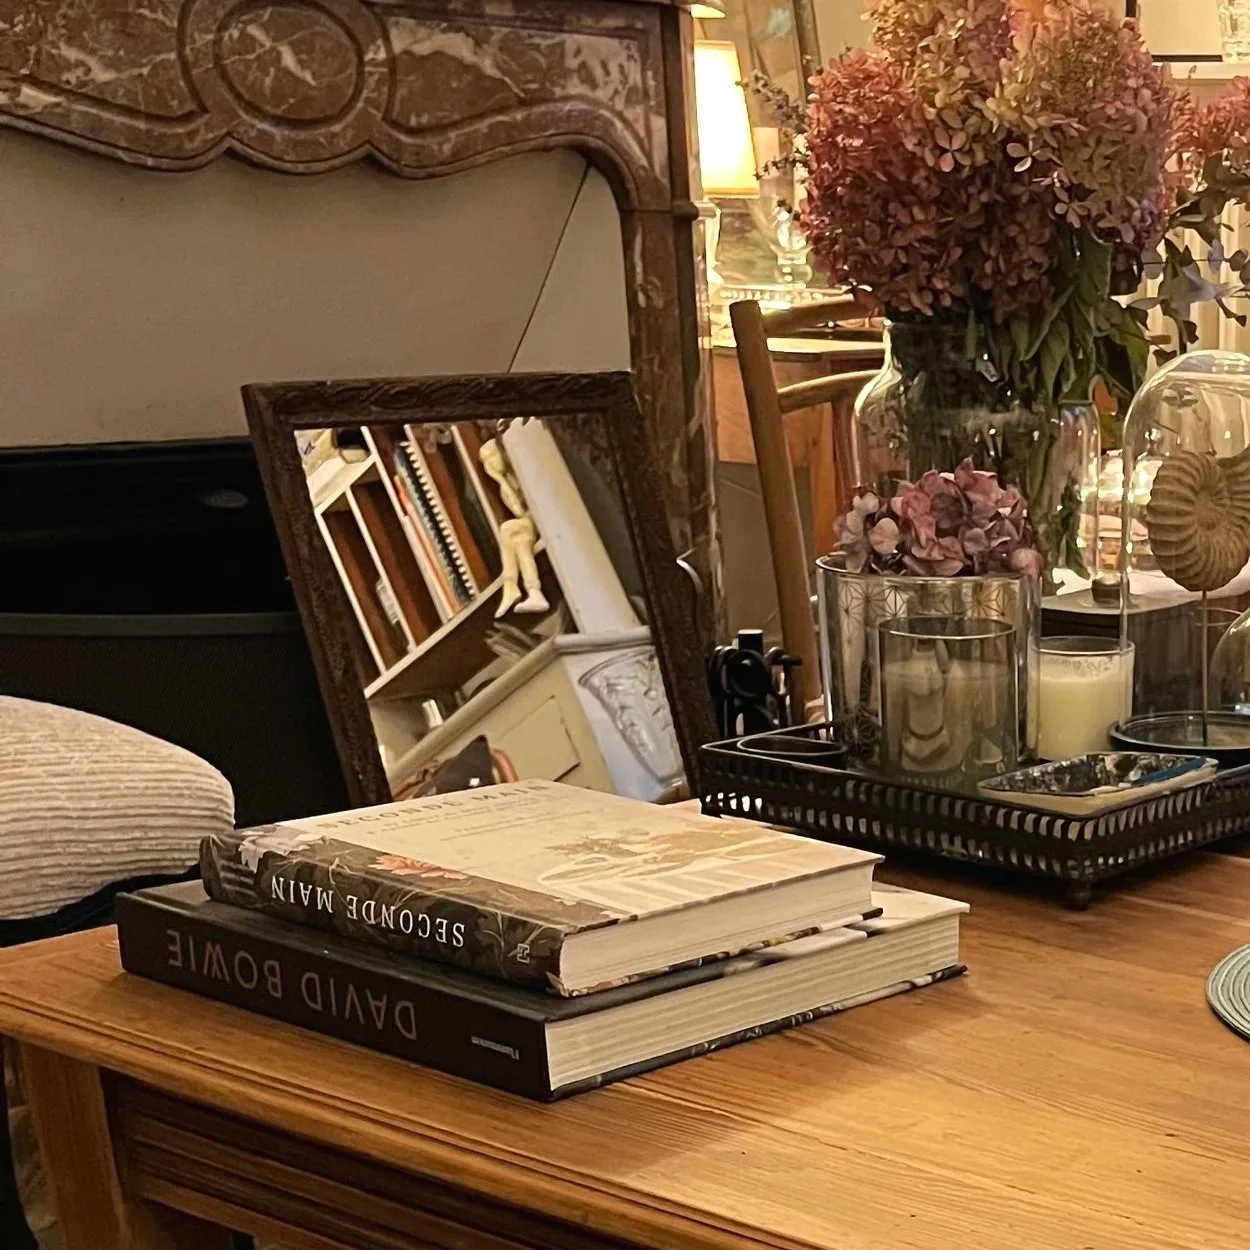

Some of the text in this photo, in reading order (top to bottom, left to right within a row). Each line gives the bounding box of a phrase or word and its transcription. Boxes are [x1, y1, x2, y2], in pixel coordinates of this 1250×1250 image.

[271, 875, 467, 948] SECONDE MAIN
[166, 929, 417, 1041] DAVID BOWIE
